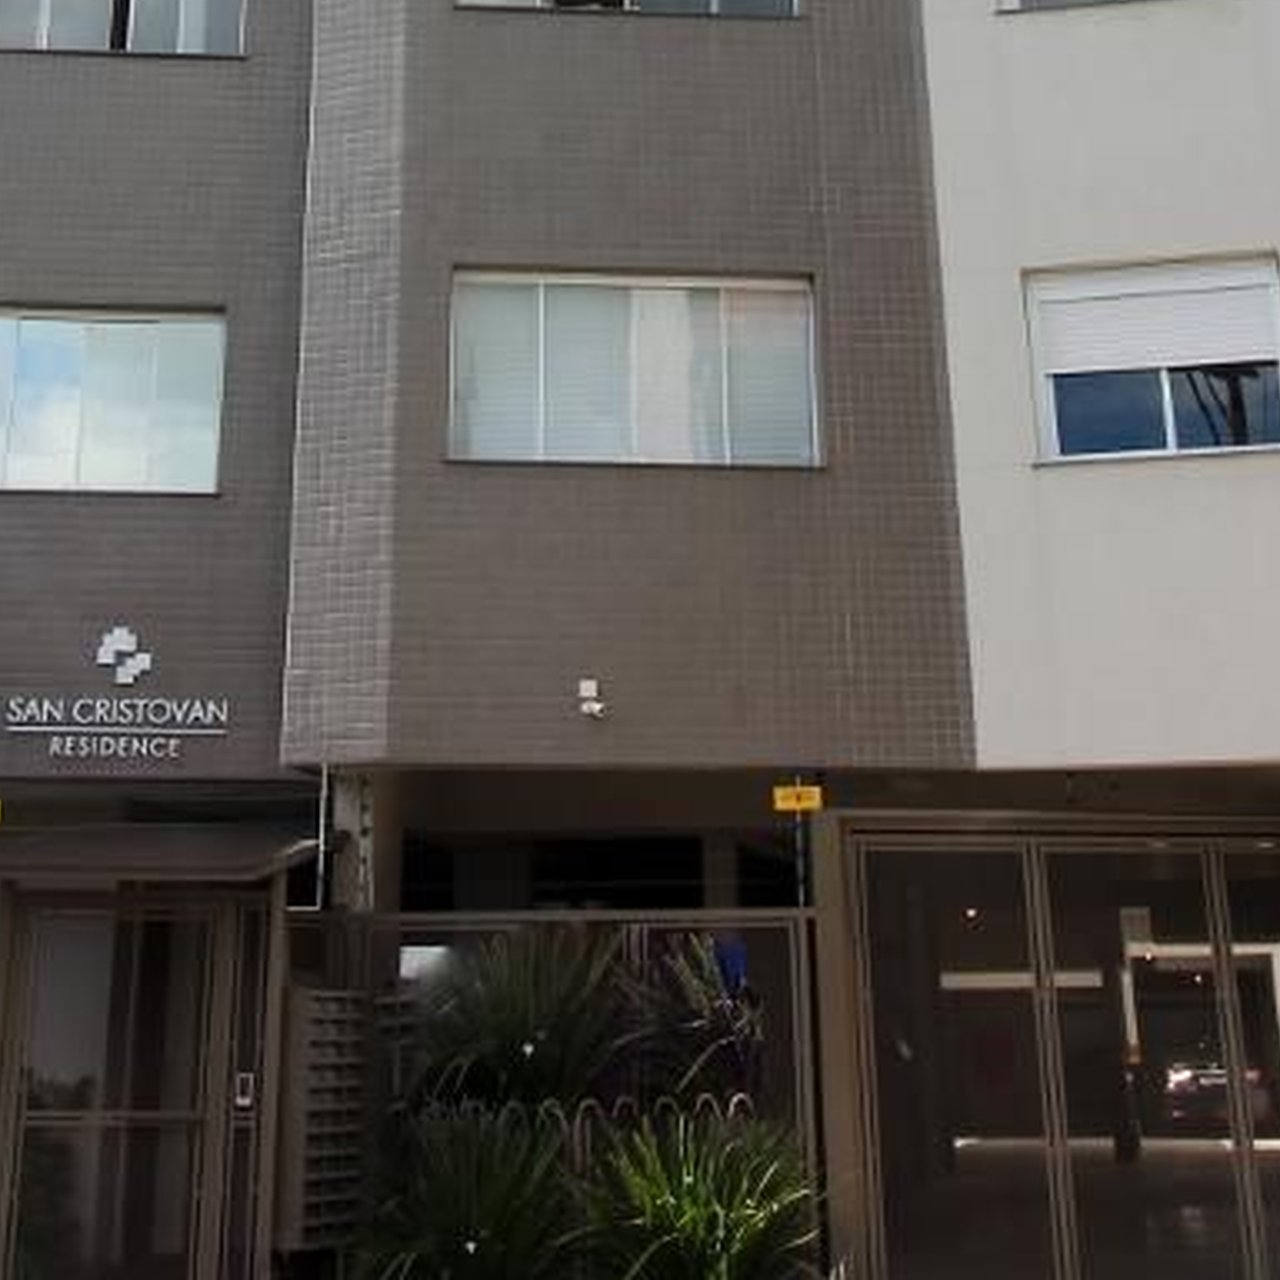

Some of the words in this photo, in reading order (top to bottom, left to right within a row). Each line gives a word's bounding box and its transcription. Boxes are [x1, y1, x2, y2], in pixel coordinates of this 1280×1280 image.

[6, 697, 64, 722] SAN
[72, 697, 229, 724] CRISTOVAN
[49, 736, 182, 758] RESIDENCE
